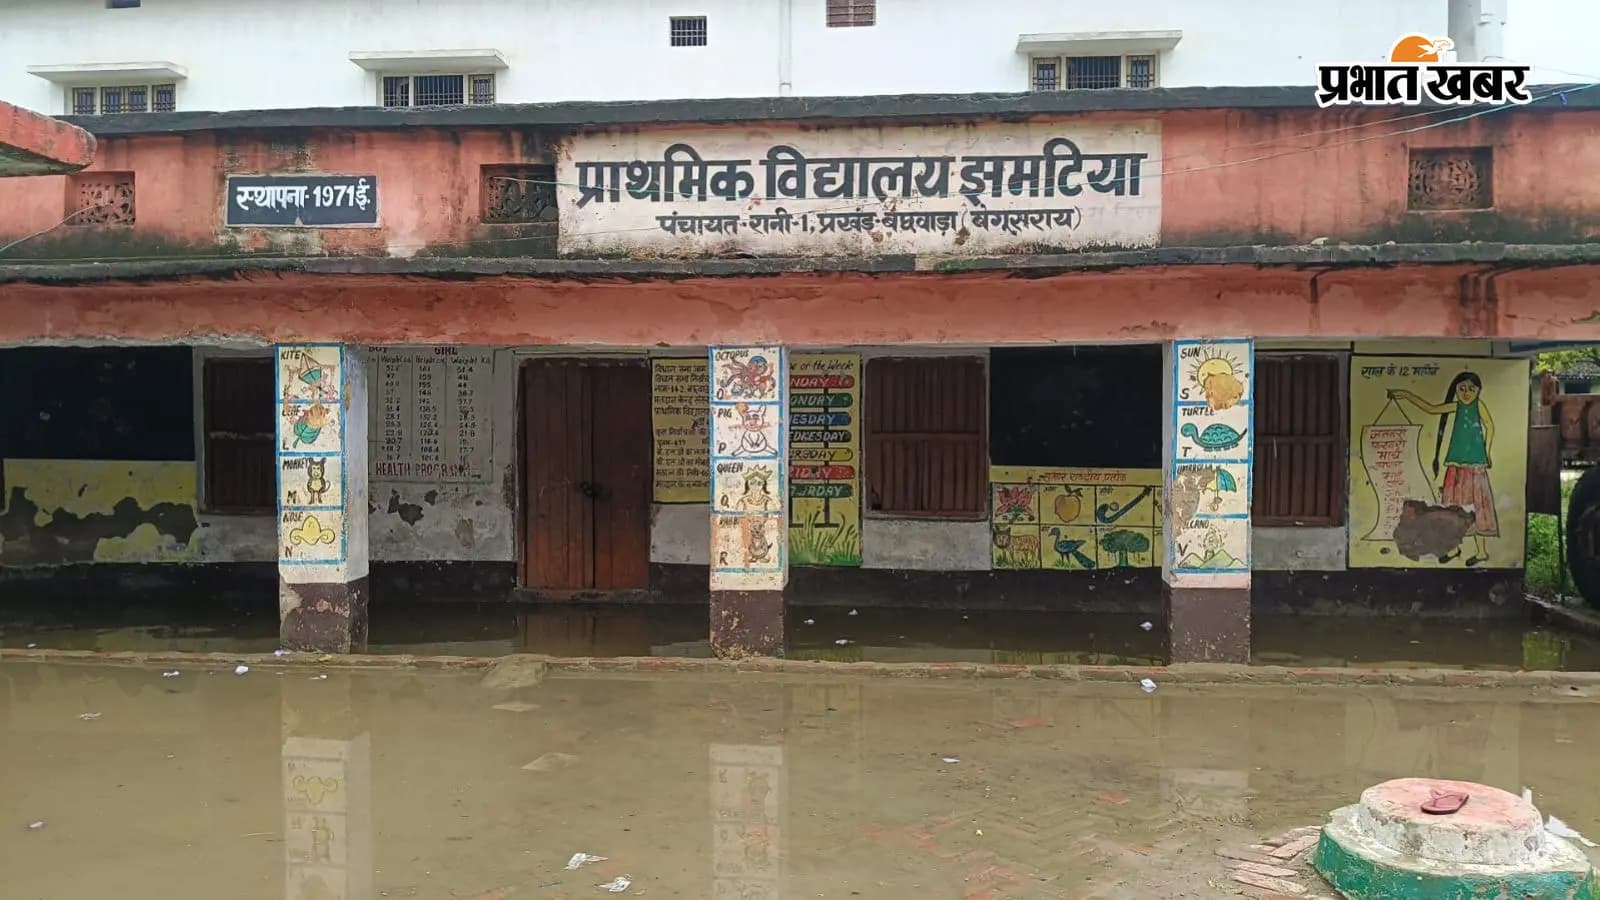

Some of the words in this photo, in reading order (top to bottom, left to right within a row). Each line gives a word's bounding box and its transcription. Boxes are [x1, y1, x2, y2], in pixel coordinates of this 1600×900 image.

[575, 143, 754, 209] प्राथमिक
[759, 145, 955, 204] विद्यालय
[959, 138, 1147, 206] झमटिया
[281, 350, 301, 360] KITE
[715, 350, 749, 361] OCTOPUS
[1180, 347, 1200, 359] SUN
[1399, 366, 1409, 376] 12
[790, 377, 829, 388] NDAY
[717, 389, 724, 400] O
[1180, 388, 1189, 399] S
[791, 394, 835, 406] ONDAY
[717, 408, 732, 418] PIG
[1181, 407, 1214, 416] TURTLE
[790, 414, 835, 425] ESDAY
[283, 441, 289, 450] L
[719, 442, 726, 454] P
[1182, 447, 1192, 458] T
[375, 463, 410, 476] HEALTH
[717, 462, 743, 473] QUEEN
[287, 491, 297, 504] M
[721, 495, 729, 508] Q
[283, 512, 303, 522] NOSE
[285, 546, 293, 558] N
[1178, 543, 1188, 556] V
[720, 551, 728, 565] R
